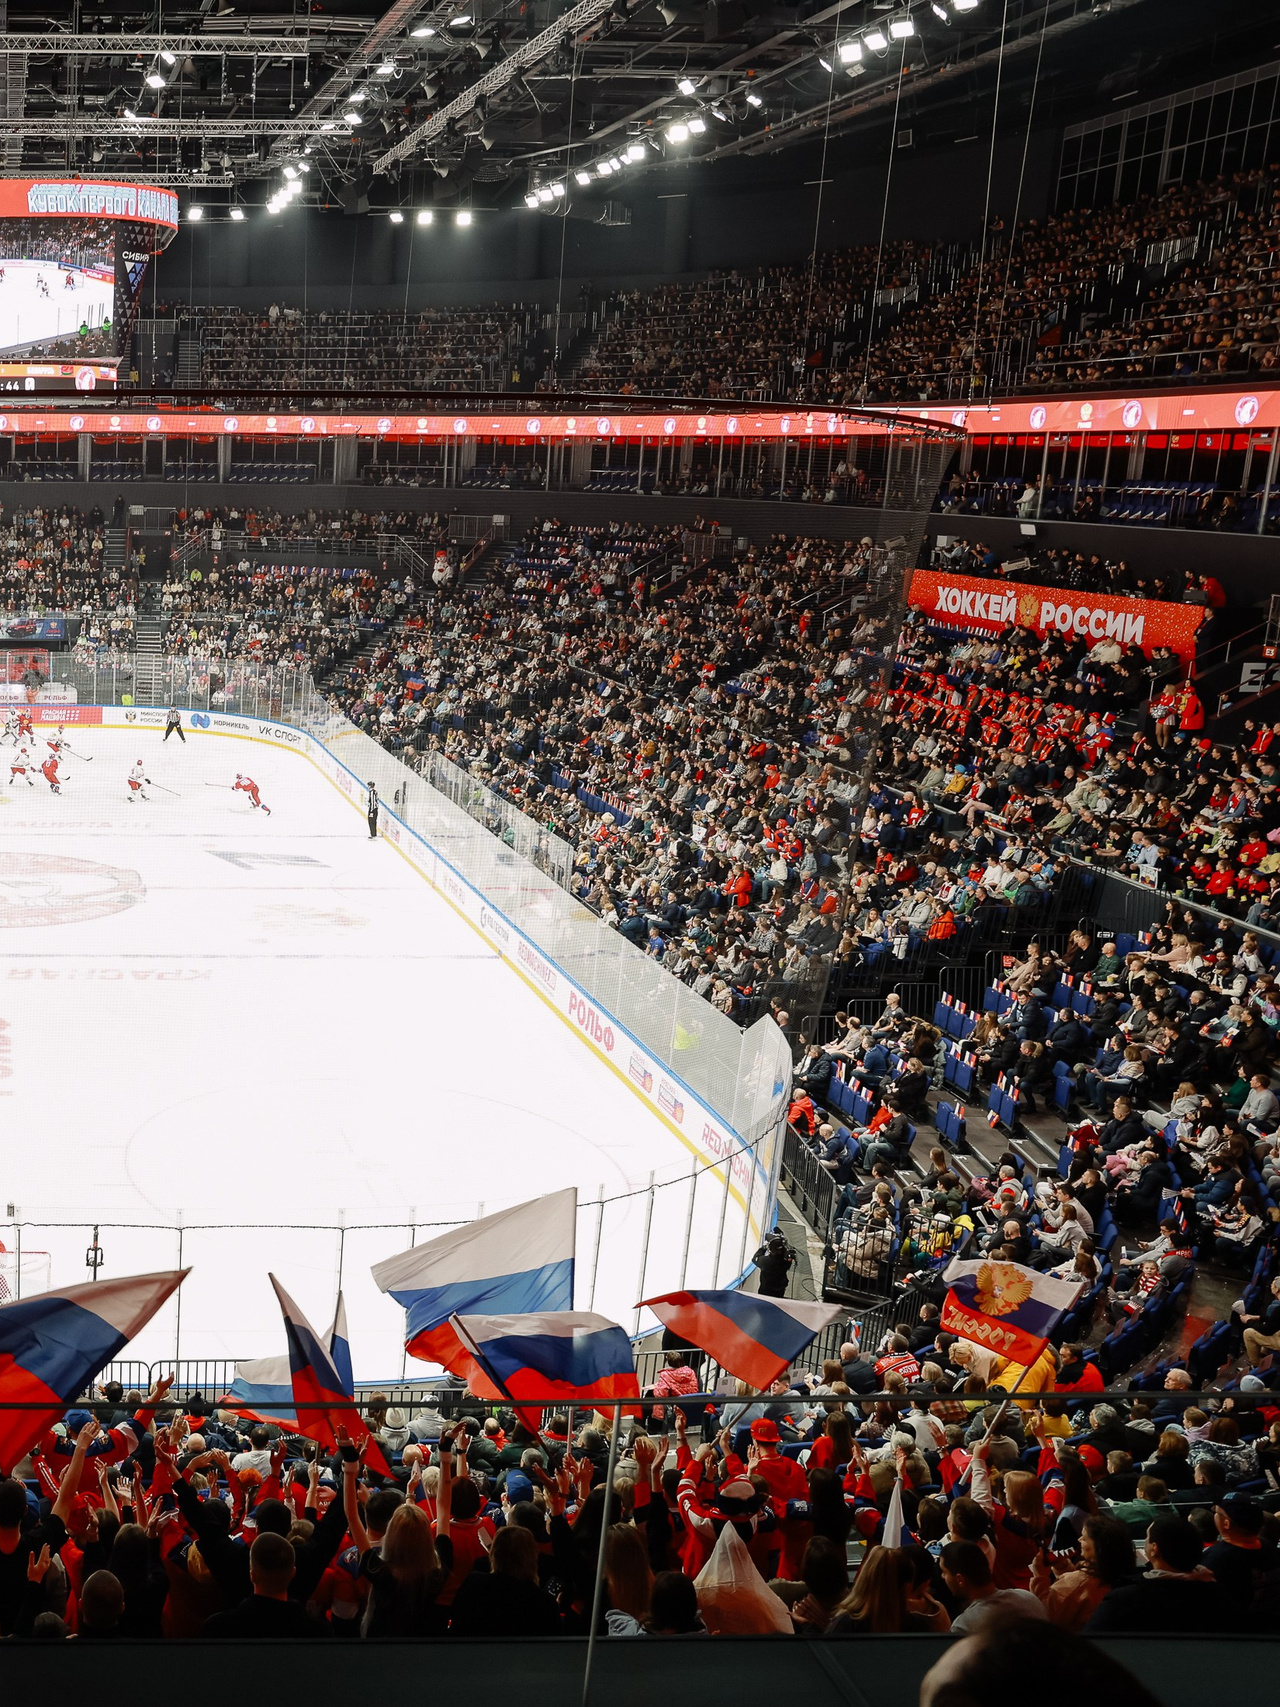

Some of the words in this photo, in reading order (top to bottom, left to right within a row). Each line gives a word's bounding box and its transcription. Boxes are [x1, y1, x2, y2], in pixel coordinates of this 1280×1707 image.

[28, 188, 78, 213] КУБОК
[79, 189, 136, 216] ПЕРВОГО
[138, 194, 170, 222] КАНАЛА
[935, 585, 1016, 622] ХОККЕЙ
[1040, 602, 1145, 645] РОССИИ
[213, 719, 250, 731] НОРНИКЕЛЬ
[258, 725, 273, 736] VK
[275, 729, 301, 744] СПОРТ
[568, 990, 615, 1051] РОЛЬФ
[702, 1122, 722, 1155] RED
